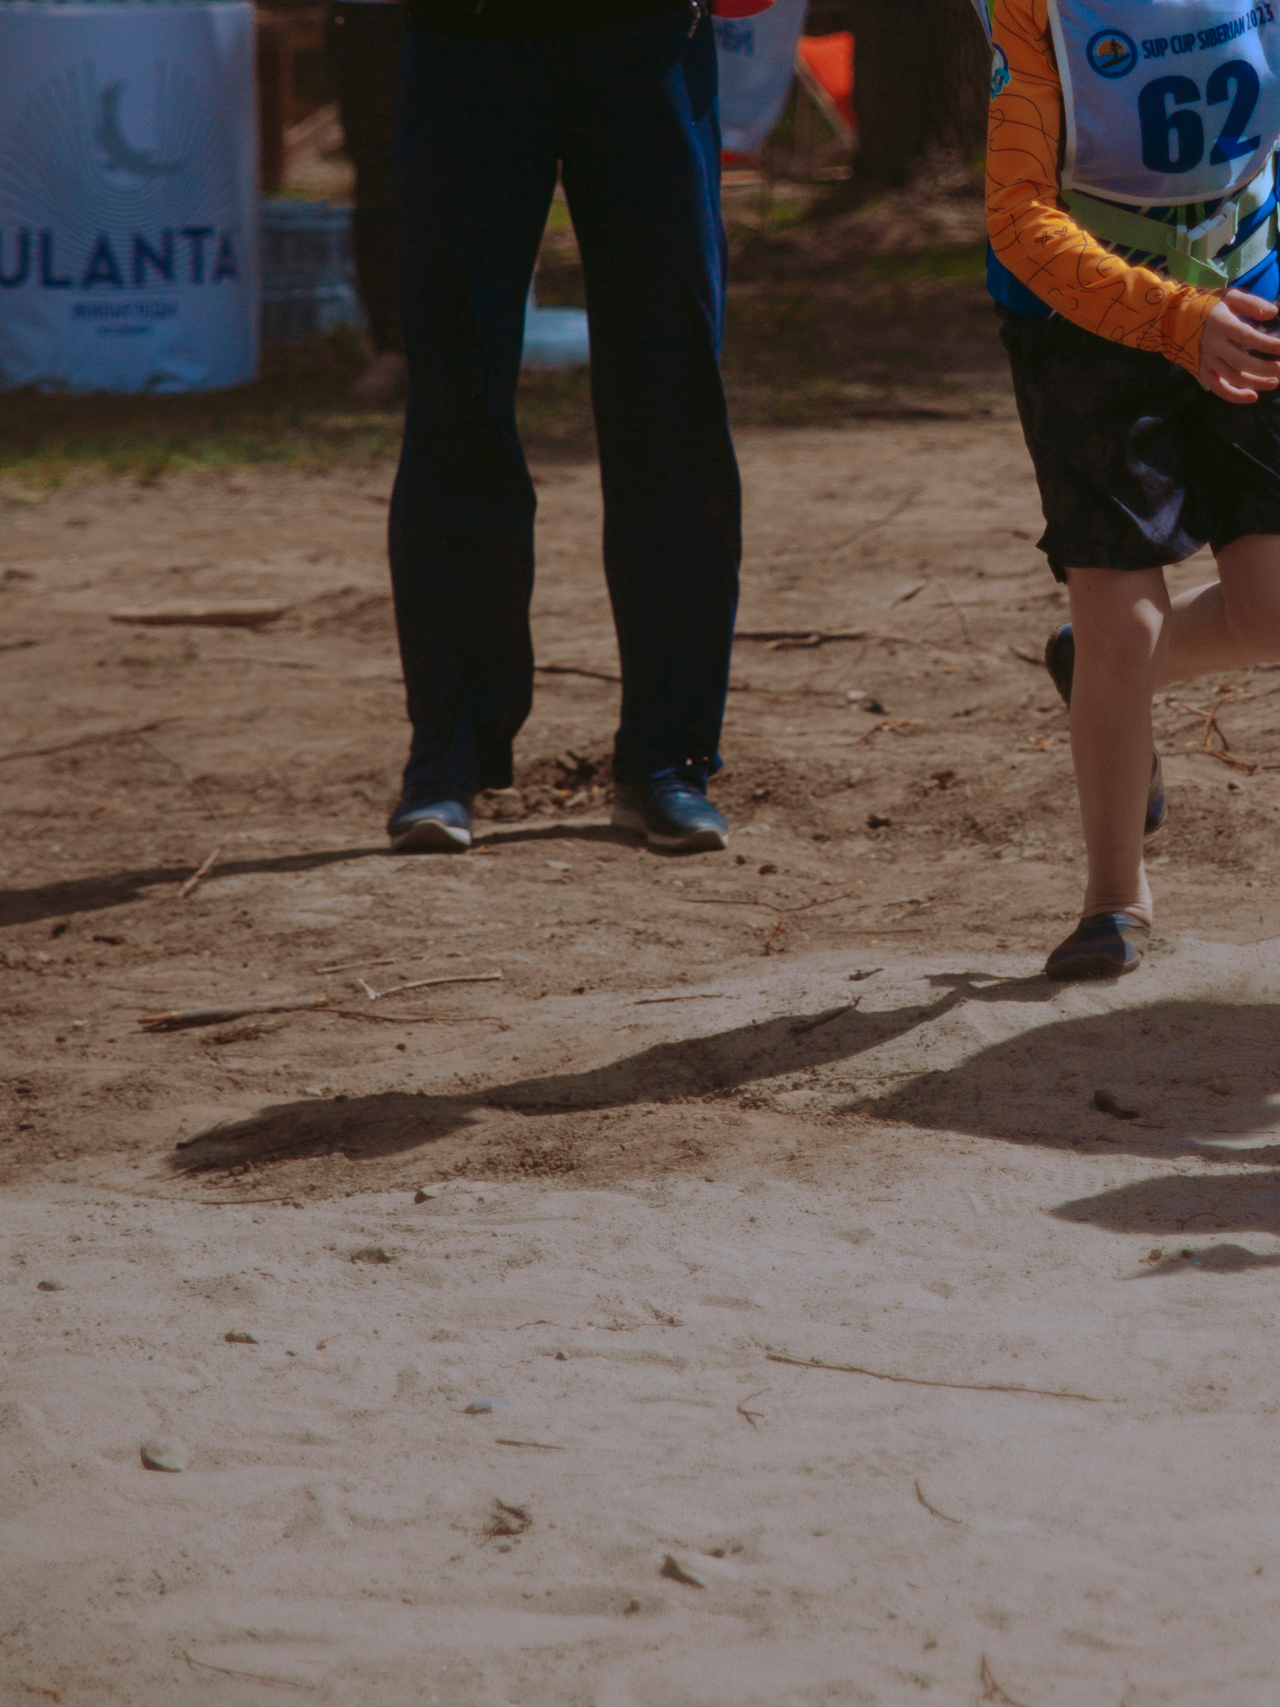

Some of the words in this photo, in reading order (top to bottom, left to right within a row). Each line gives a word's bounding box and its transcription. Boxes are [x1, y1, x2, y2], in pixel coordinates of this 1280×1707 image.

[1142, 37, 1168, 59] SUP
[1170, 33, 1196, 55] CUP
[1197, 16, 1246, 50] SIBERIAN
[1245, 2, 1274, 31] 2023
[1138, 59, 1262, 175] 62
